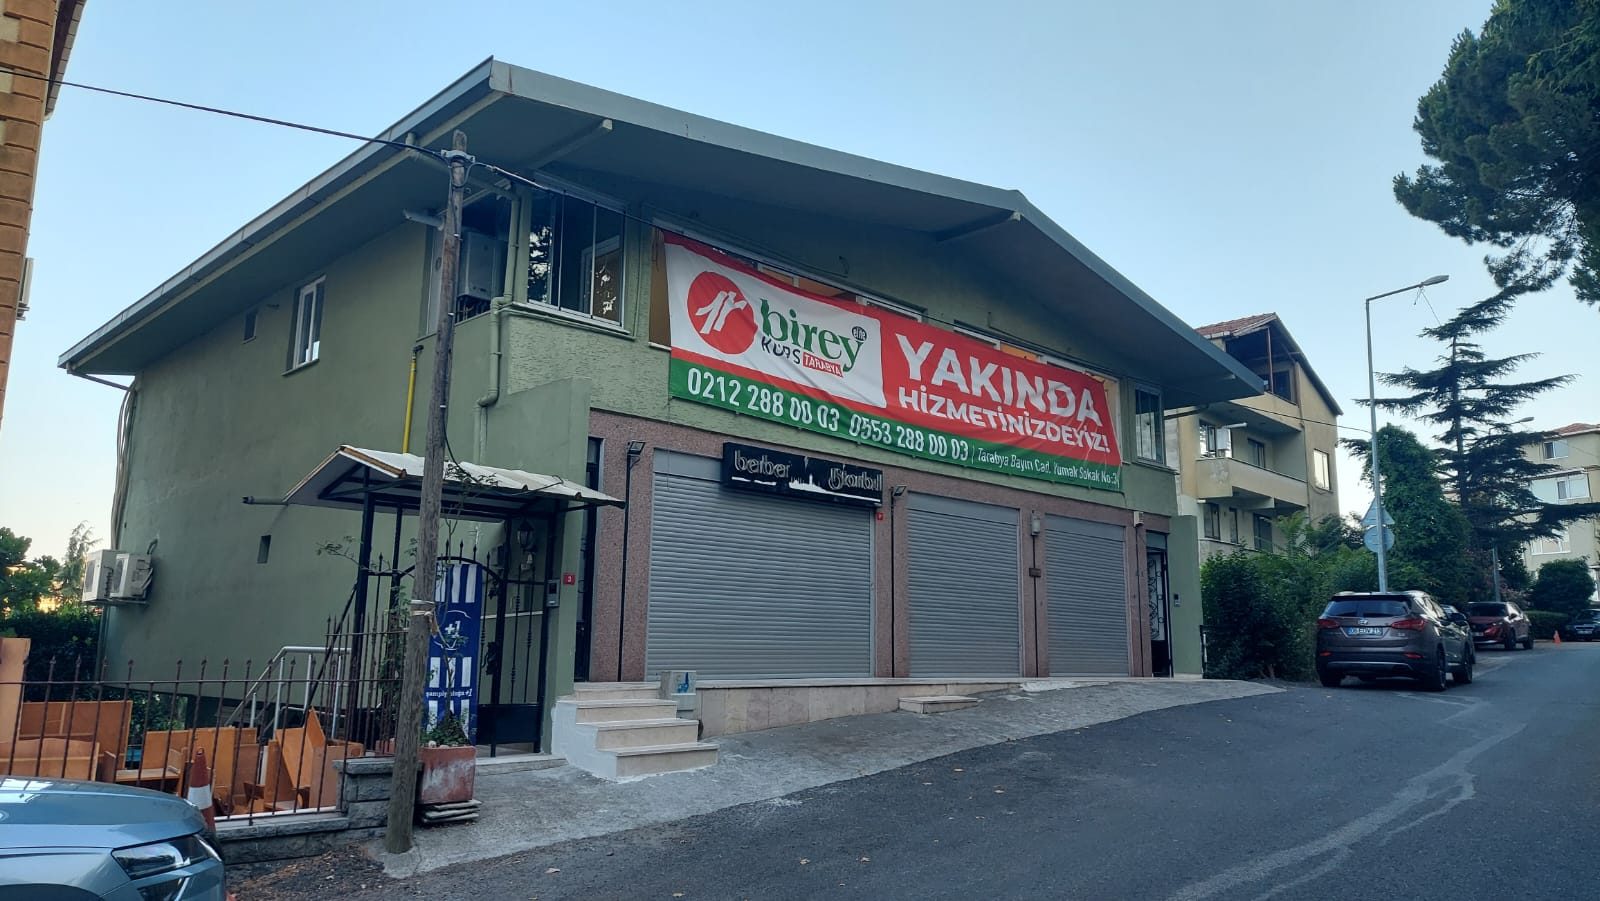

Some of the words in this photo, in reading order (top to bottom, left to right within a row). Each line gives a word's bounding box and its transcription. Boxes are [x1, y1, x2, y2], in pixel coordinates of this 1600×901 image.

[760, 298, 863, 372] birey
[761, 336, 800, 364] KURS
[804, 354, 842, 377] TARABYA
[895, 333, 1102, 426] YAKINDA
[687, 367, 740, 406] 0212
[747, 385, 784, 417] 288
[789, 397, 813, 424] 00
[817, 405, 840, 431] 03
[898, 384, 1111, 453] HİZMETİNİZDEYİZ!
[849, 413, 892, 445] 0553
[896, 426, 925, 452] 288
[929, 433, 947, 457] 00
[951, 438, 969, 461] 03
[978, 447, 1009, 467] Tarabya
[1053, 462, 1078, 478] Yumak
[1079, 466, 1100, 482] Sokak
